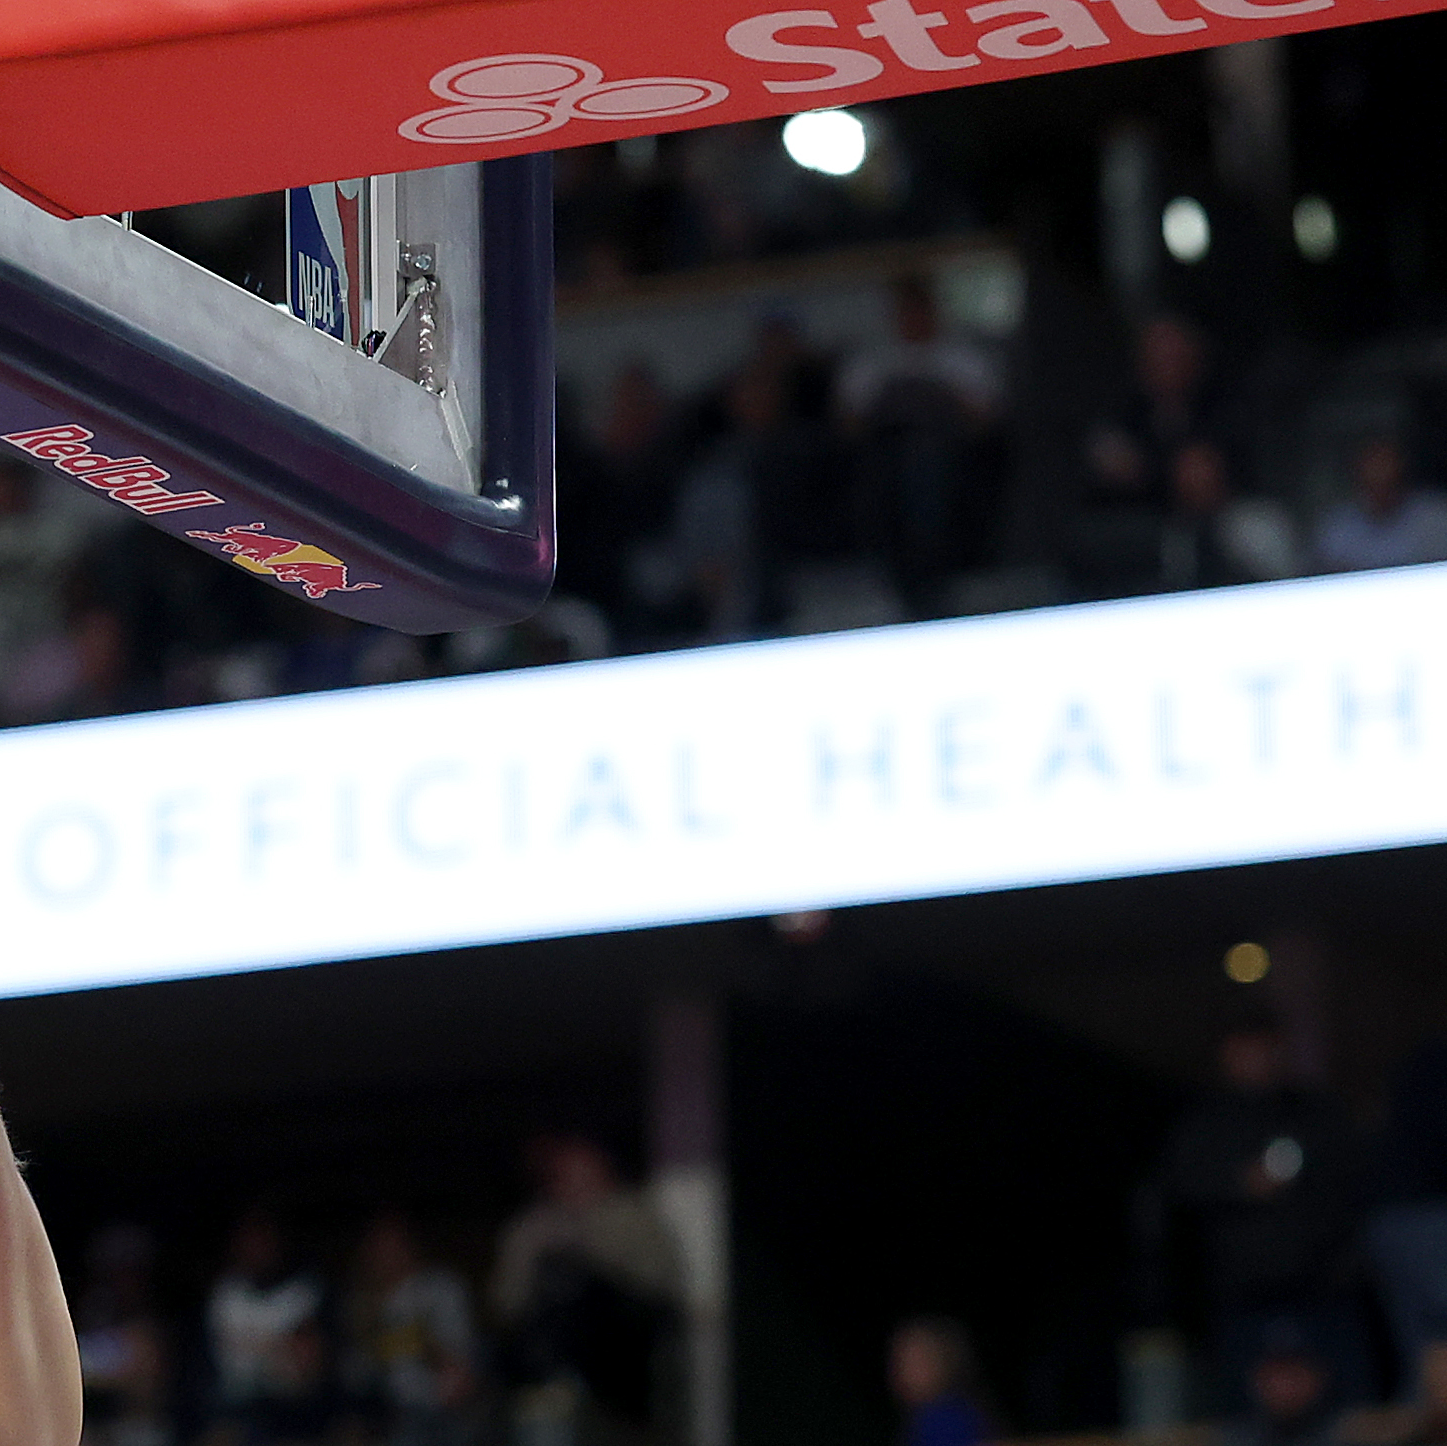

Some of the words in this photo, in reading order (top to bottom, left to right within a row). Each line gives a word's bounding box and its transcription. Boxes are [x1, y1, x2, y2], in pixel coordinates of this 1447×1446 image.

[725, 0, 1337, 94] Stat
[298, 250, 336, 329] NBA
[13, 732, 735, 914] OFFICIAL
[807, 650, 1429, 822] HEALTH
